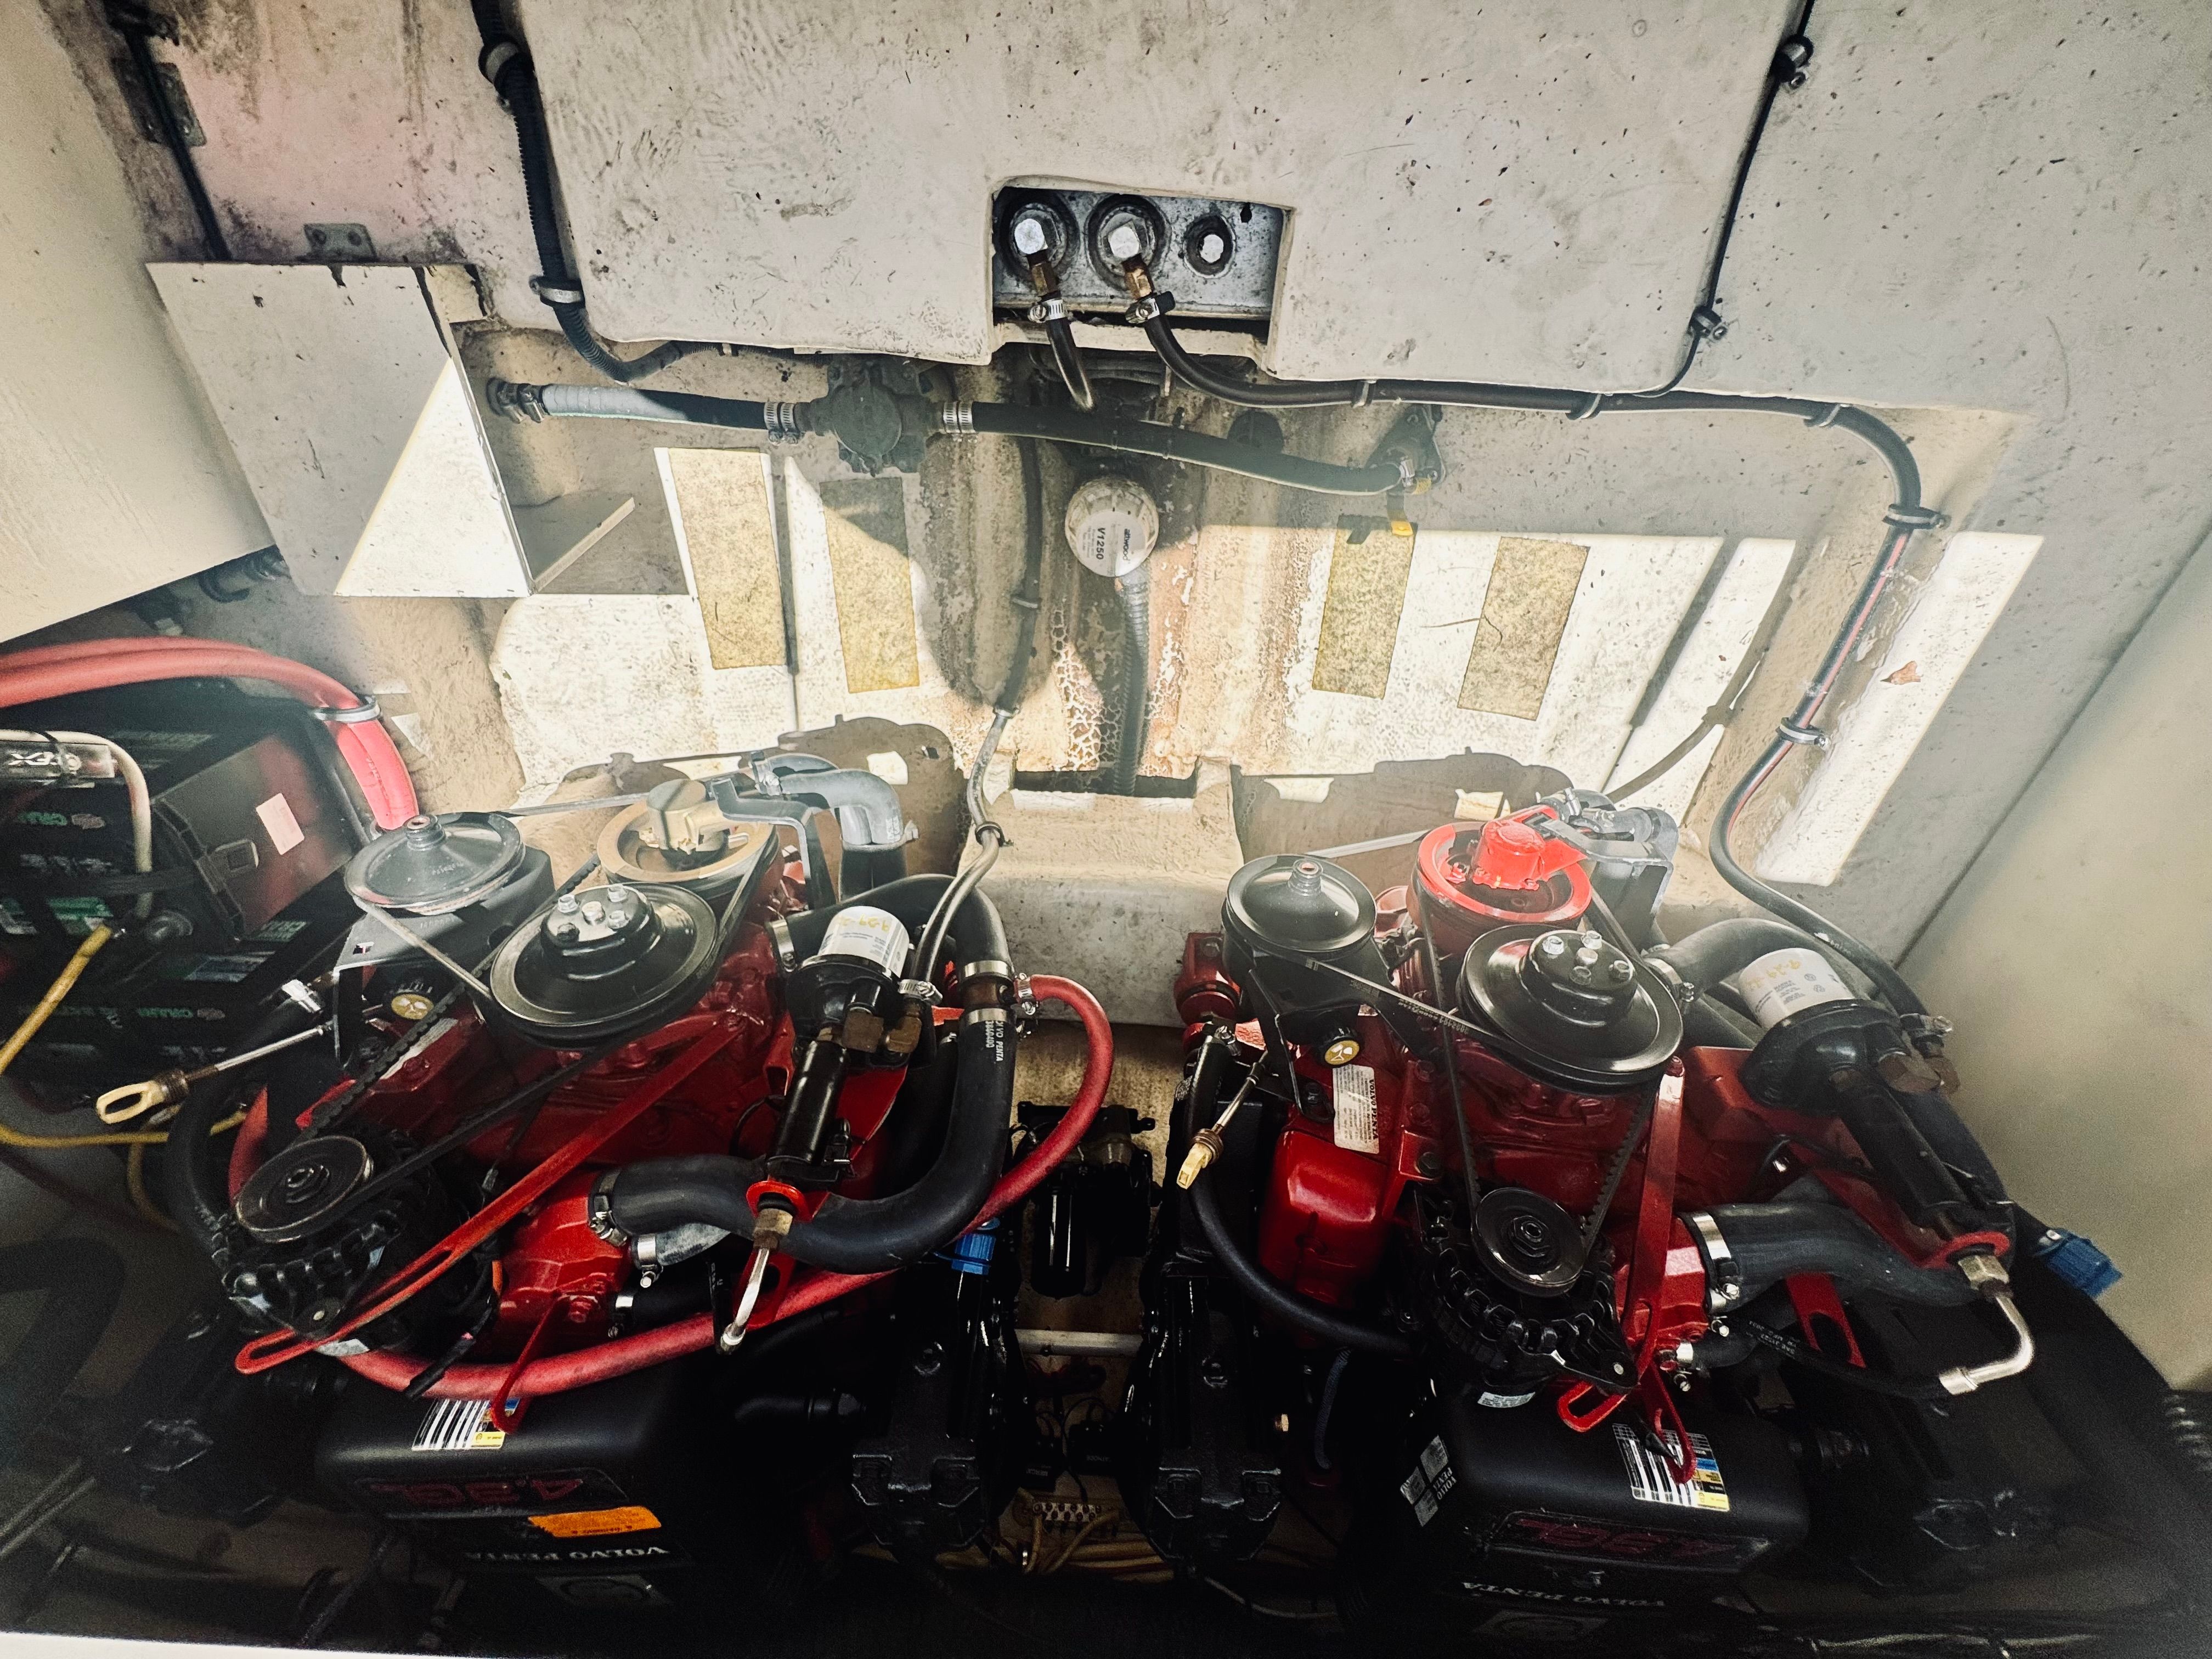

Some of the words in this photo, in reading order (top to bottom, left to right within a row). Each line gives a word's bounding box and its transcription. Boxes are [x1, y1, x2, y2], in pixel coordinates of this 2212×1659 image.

[1096, 527, 1106, 560] V1250
[1122, 528, 1131, 561] attwood
[996, 1041, 1004, 1062] PENTA
[568, 1545, 671, 1561] VOLVO
[1460, 1582, 1565, 1601] PENTA
[1572, 1595, 1666, 1607] VOLVO
